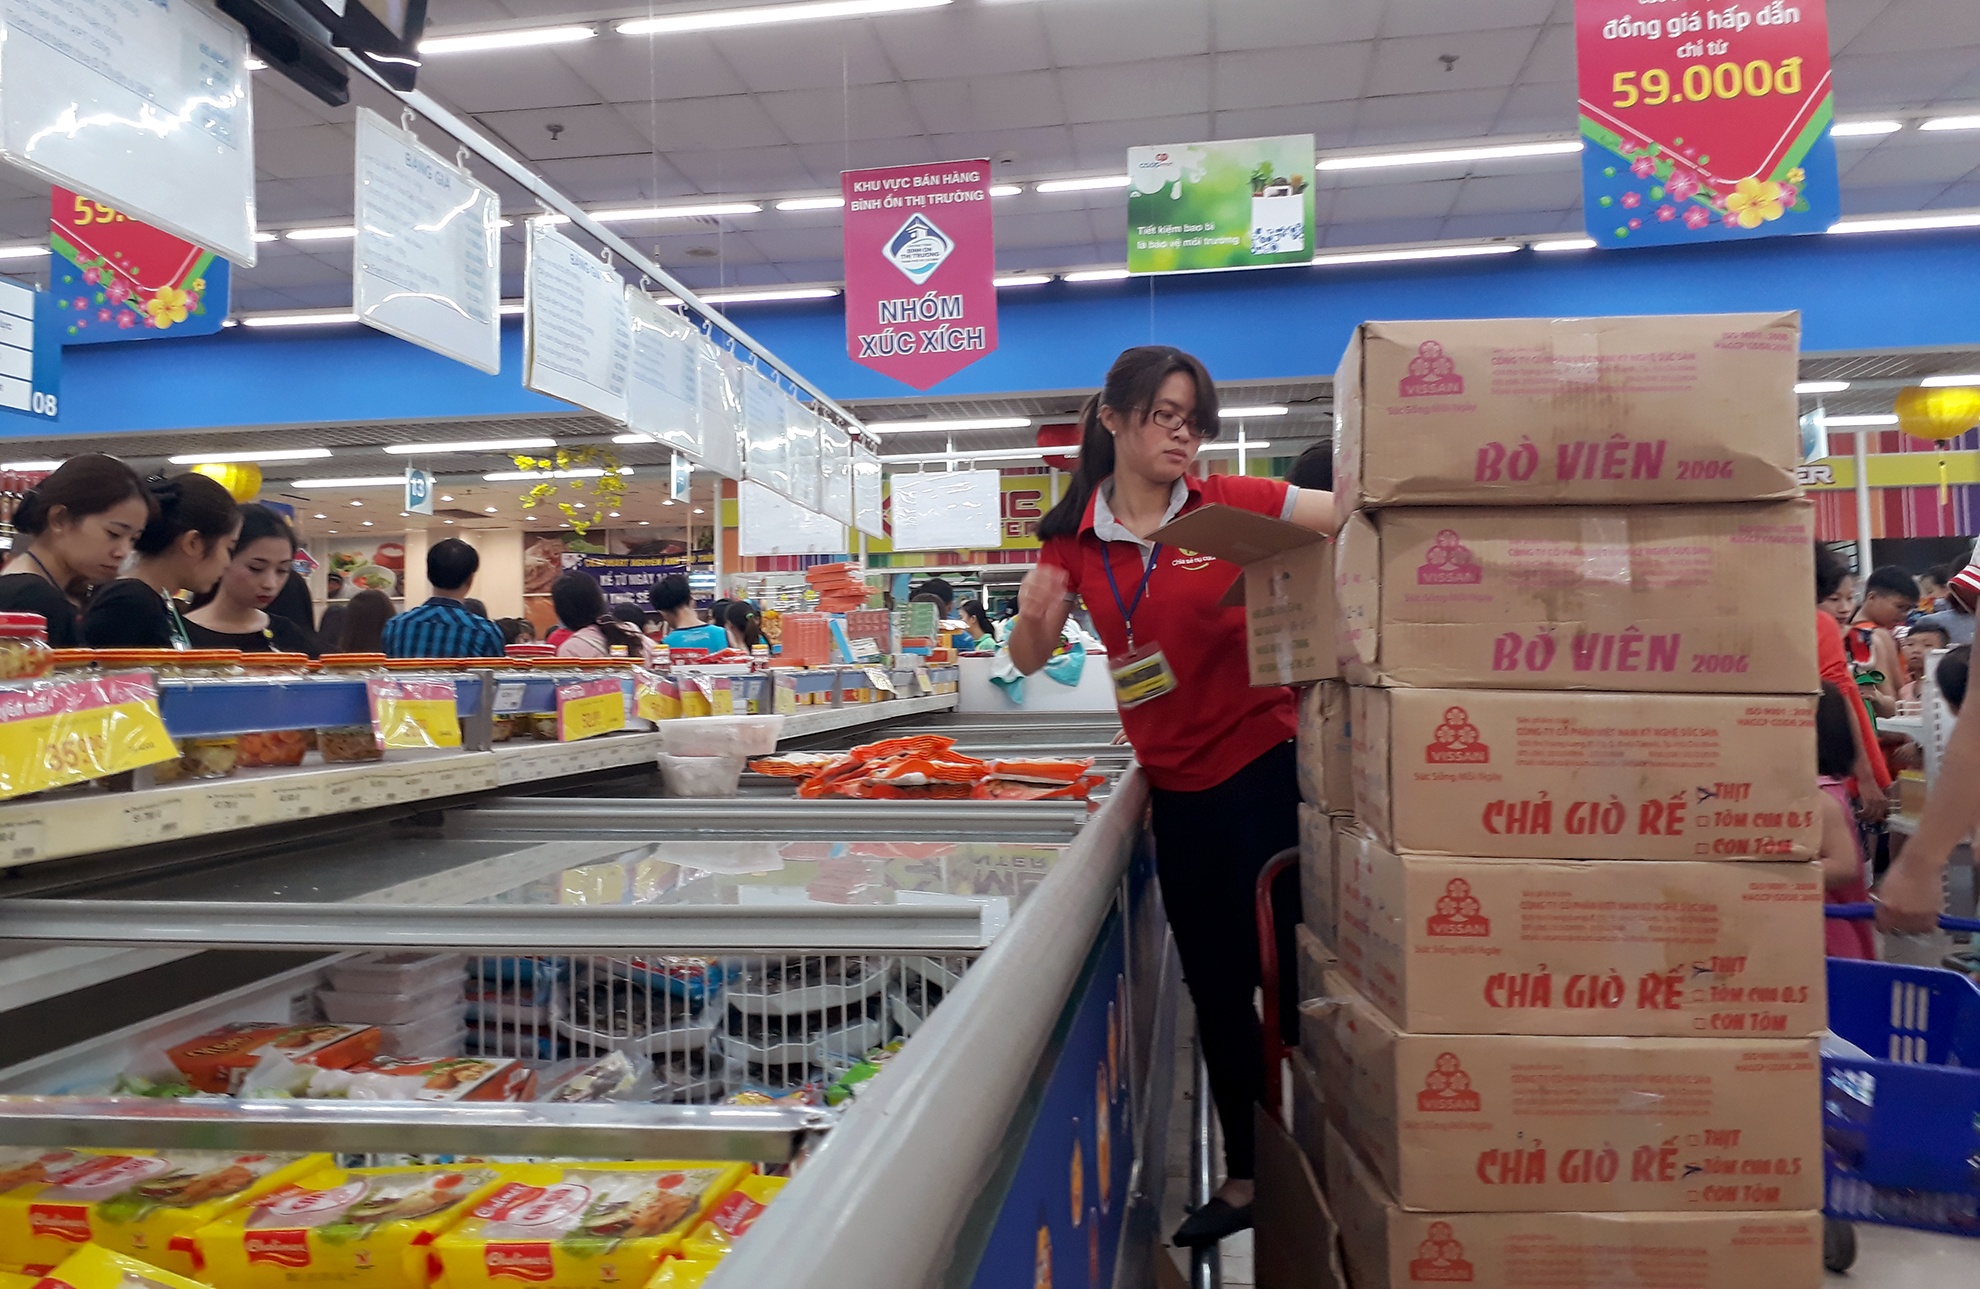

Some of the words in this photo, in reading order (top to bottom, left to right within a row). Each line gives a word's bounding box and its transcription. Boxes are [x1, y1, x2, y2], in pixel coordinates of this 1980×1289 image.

[1603, 15, 1661, 39] đồng
[1666, 12, 1702, 38] giá
[1707, 5, 1750, 32] hấp
[1756, 1, 1800, 26] dẫn
[1676, 39, 1704, 58] chỉ
[1612, 56, 1803, 108] 59.000đ
[854, 181, 881, 193] KHU
[883, 177, 911, 191] VỰC
[914, 174, 940, 188] BÁN
[943, 171, 980, 185] HÀNG
[851, 197, 880, 212] BÌNH
[883, 194, 903, 209] ỔN
[904, 196, 926, 208] THỊ
[928, 190, 984, 204] TRƯỜNG
[878, 291, 963, 324] NHÓM
[858, 328, 916, 358] XÚC
[919, 323, 985, 353] XÍCH
[1405, 382, 1460, 395] VISSAN
[32, 392, 58, 416] 08
[1475, 434, 1540, 482] BÒ
[1556, 432, 1666, 481] VIÊN
[1421, 572, 1476, 583] VISSAN
[1491, 626, 1556, 672] BÒ
[1572, 625, 1681, 673] VIÊN
[1430, 751, 1486, 761] VISSAN
[1713, 782, 1752, 802] THỊT
[1482, 789, 1553, 835] CHẢ
[1564, 794, 1626, 835] GIÒ
[1638, 790, 1688, 836] RẾ
[1714, 809, 1748, 828] TÔM
[1713, 838, 1749, 854] CON
[1754, 836, 1793, 854] TÔM
[1430, 923, 1486, 934] VISSAN
[1483, 963, 1553, 1008] CHẢ
[1563, 967, 1625, 1009] GIÒ
[1636, 964, 1686, 1010] RẾ
[1710, 1013, 1745, 1030] CON
[1750, 1011, 1788, 1031] TÔM
[1421, 1099, 1477, 1110] VISSAN
[1476, 1139, 1546, 1184] CHẢ
[1558, 1141, 1619, 1183] GIÒ
[1630, 1135, 1679, 1182] RẾ
[1702, 1185, 1738, 1202] CON
